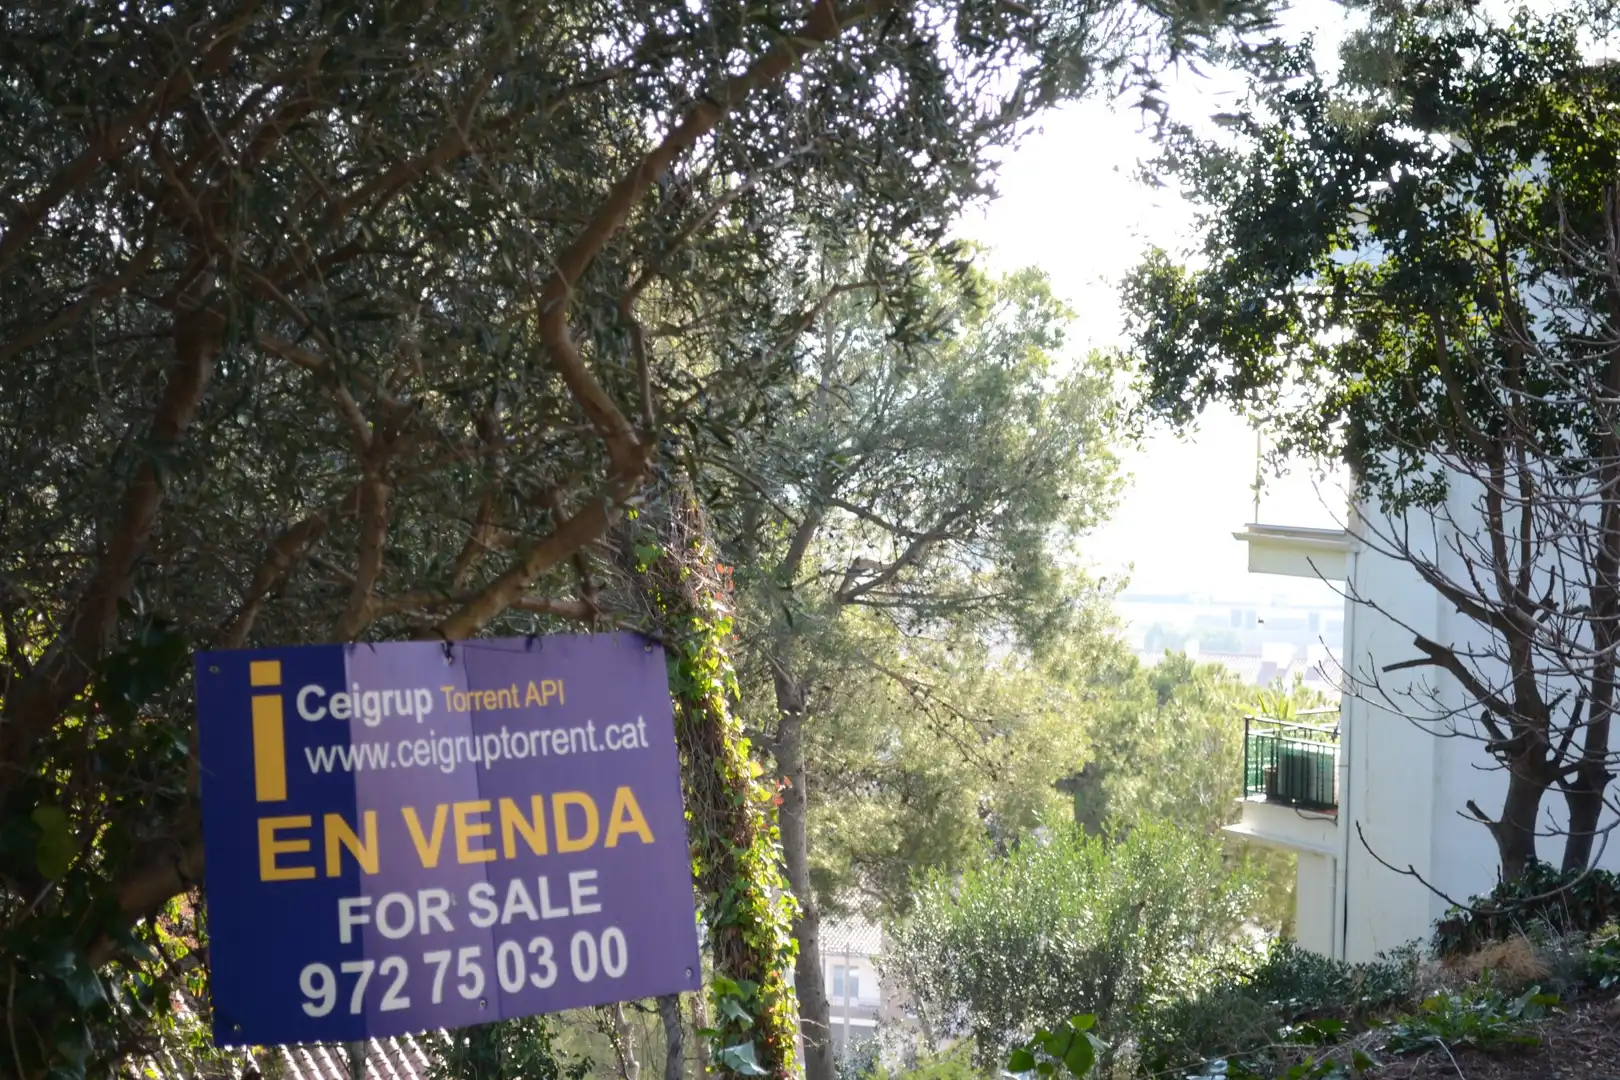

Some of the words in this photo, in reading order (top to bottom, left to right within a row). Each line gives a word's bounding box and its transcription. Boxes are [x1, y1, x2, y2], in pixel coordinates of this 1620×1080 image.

[296, 684, 434, 728] Ceigrup
[440, 683, 521, 713] Torrent
[525, 679, 566, 708] API
[304, 715, 650, 774] www.ceigruptorrent.cat
[257, 810, 380, 882] EN
[402, 786, 655, 869] VENDA
[338, 888, 454, 944] FOR
[468, 869, 602, 929] SALE
[299, 957, 411, 1018] 972
[423, 946, 485, 1003] 75
[496, 936, 558, 994] 03
[570, 926, 628, 984] 00
